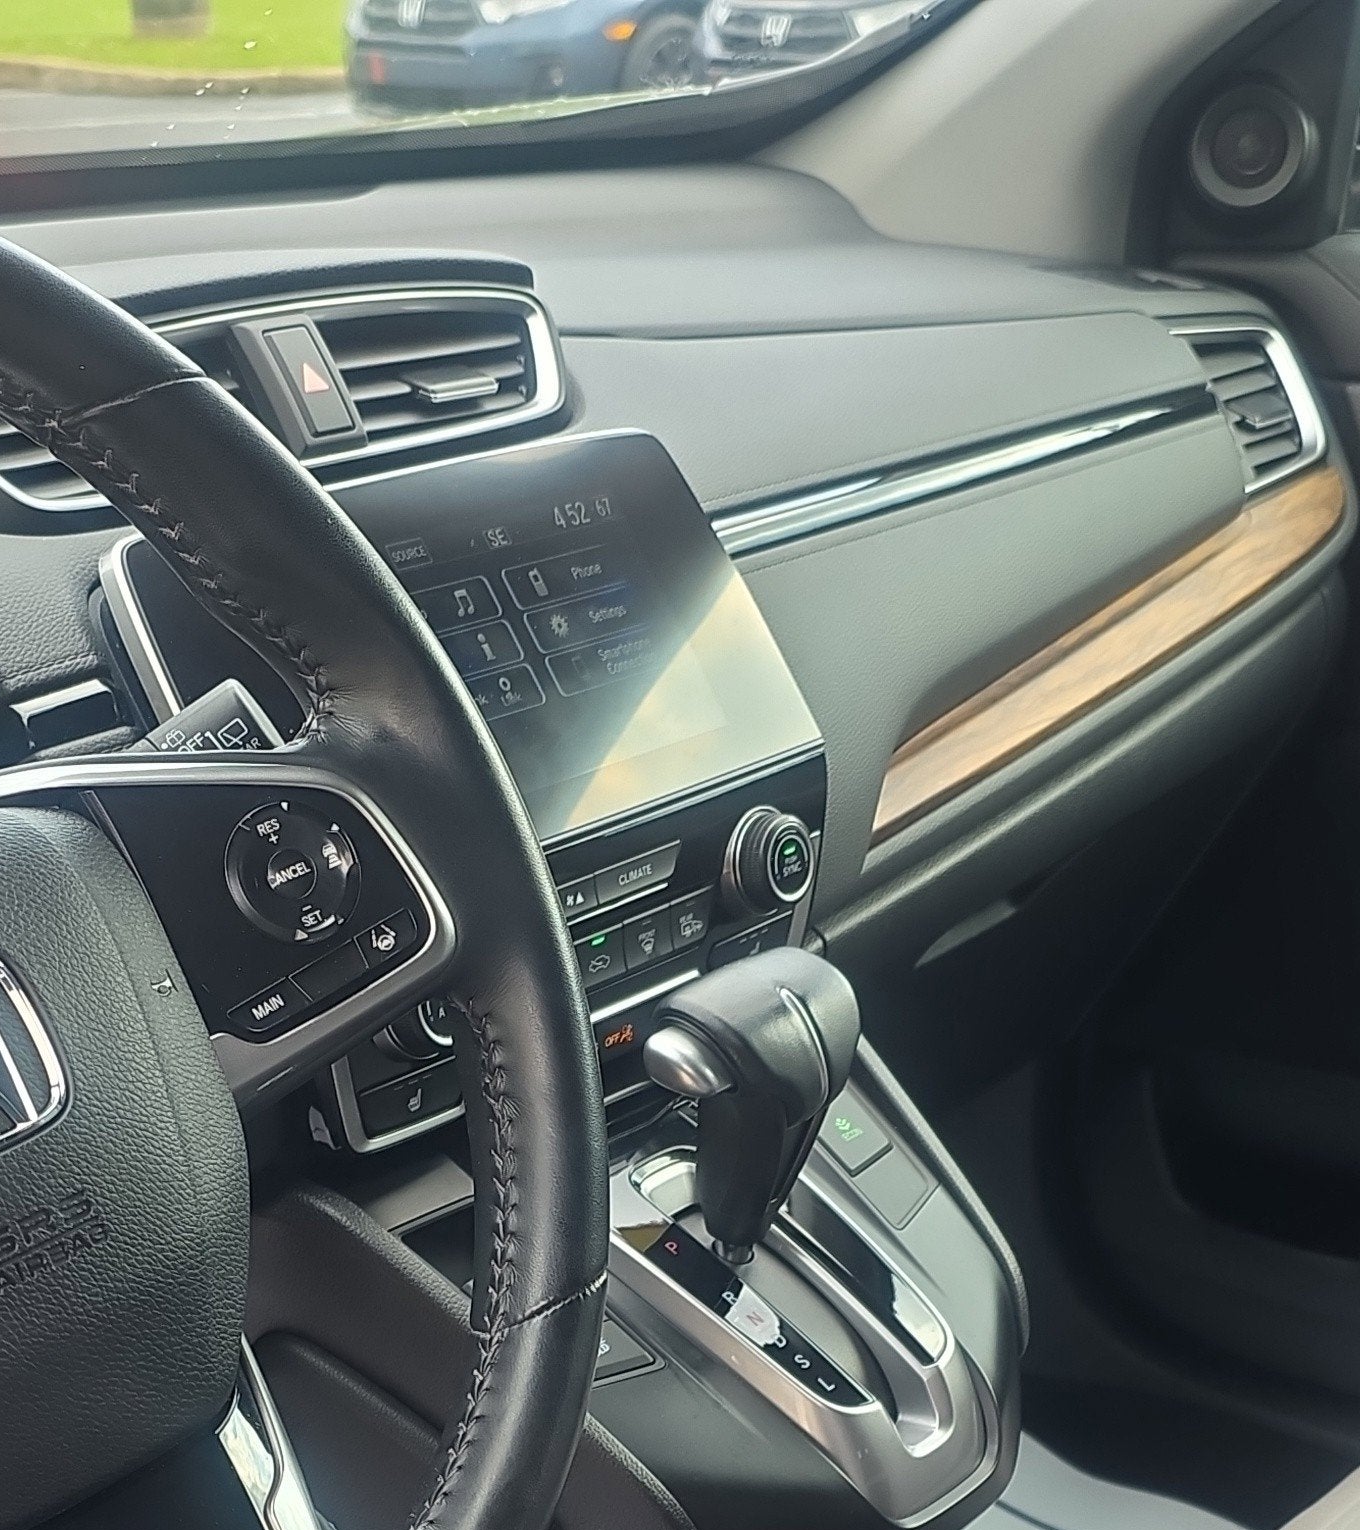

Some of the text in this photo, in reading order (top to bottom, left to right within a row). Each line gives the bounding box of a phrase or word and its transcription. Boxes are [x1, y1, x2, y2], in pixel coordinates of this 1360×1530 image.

[391, 545, 428, 564] SOURCE
[570, 562, 603, 581] Phone
[588, 604, 628, 624] Settings
[256, 818, 280, 837] RES
[267, 861, 312, 889] CANCEL
[618, 863, 653, 886] CLIMATE
[301, 909, 323, 927] SET
[251, 993, 285, 1022] MAIN
[664, 1240, 678, 1256] P
[721, 1290, 739, 1306] R
[745, 1310, 765, 1327] N
[793, 1353, 812, 1370] S
[817, 1376, 837, 1392] L
